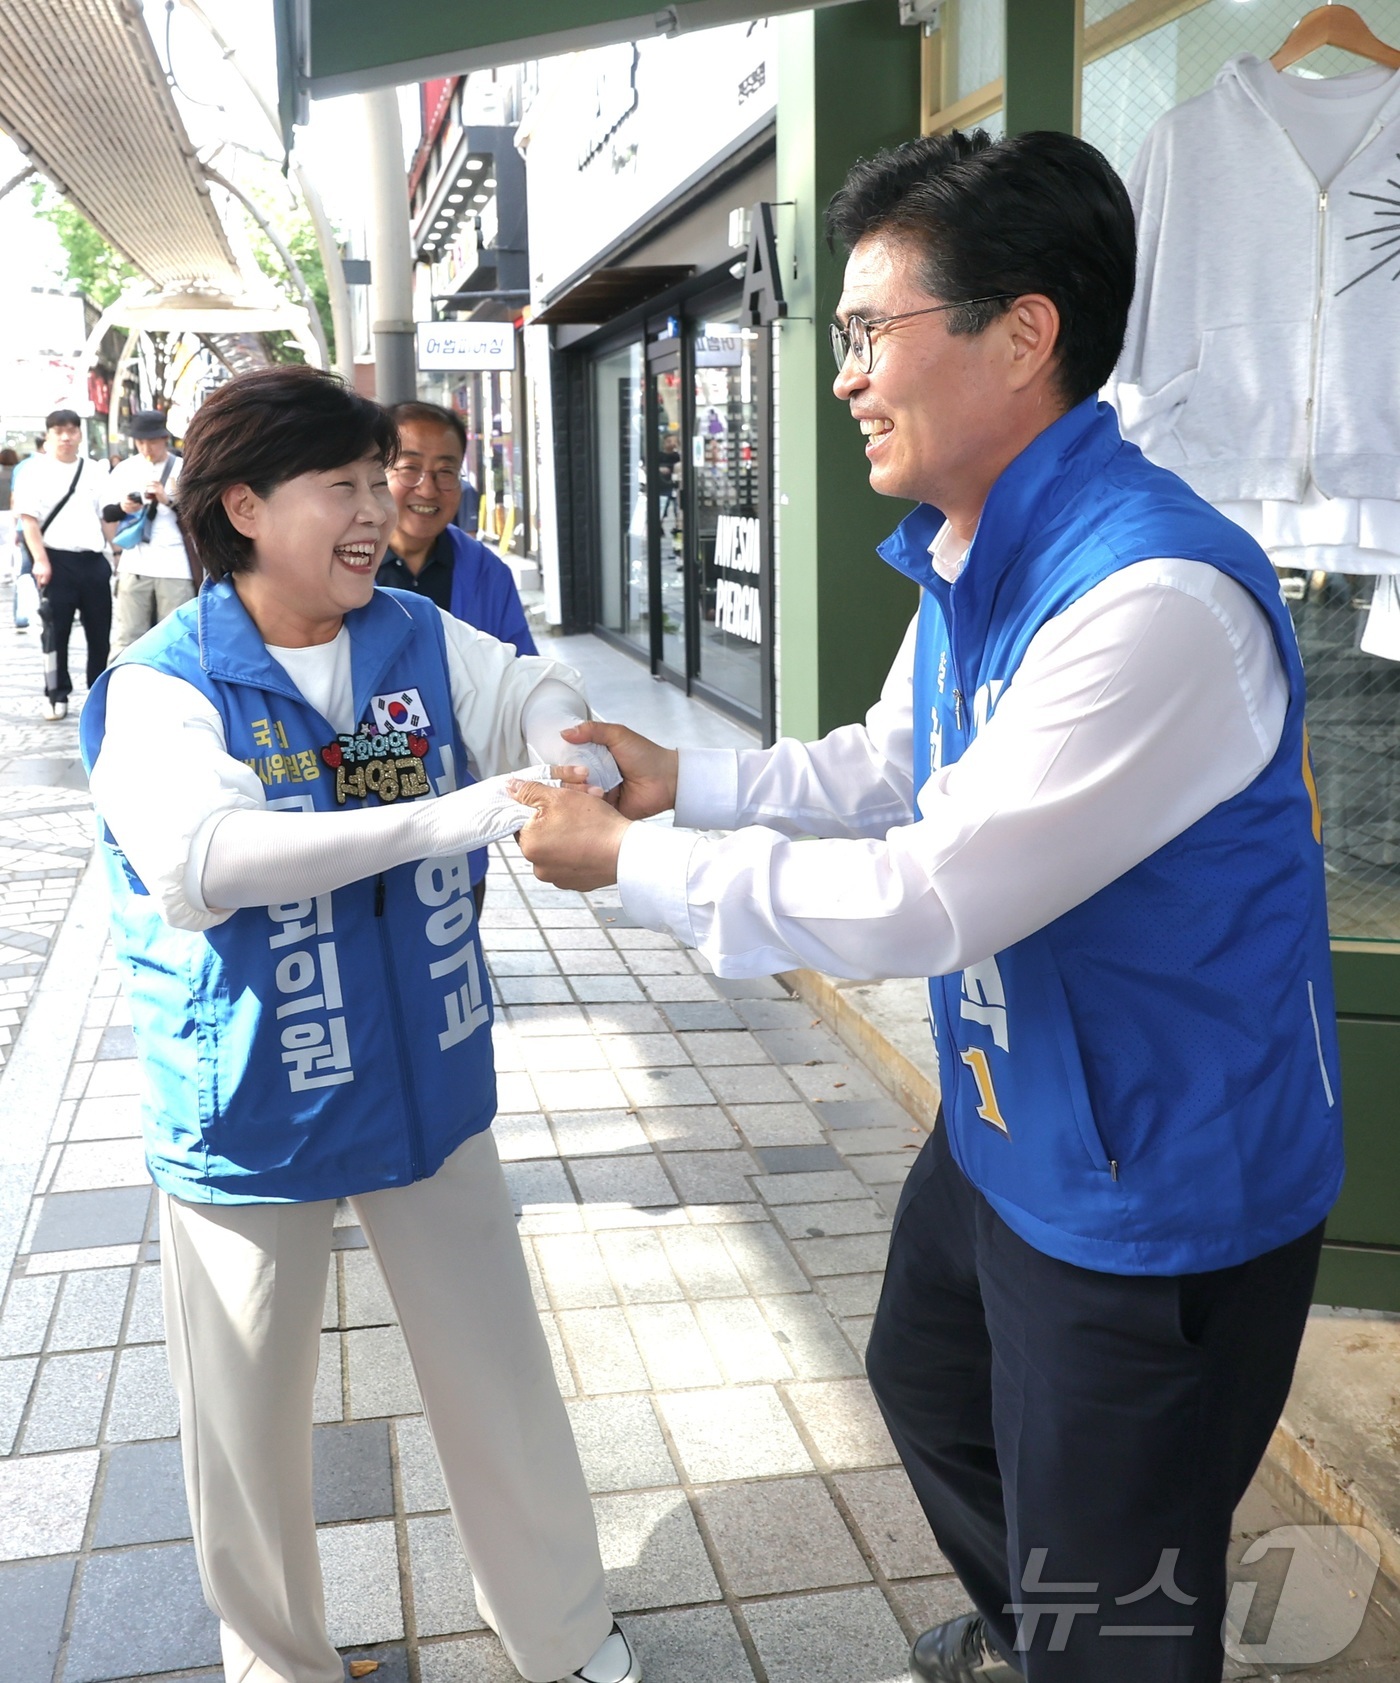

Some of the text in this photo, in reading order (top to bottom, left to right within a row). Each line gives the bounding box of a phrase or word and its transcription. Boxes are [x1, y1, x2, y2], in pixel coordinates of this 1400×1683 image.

[740, 202, 787, 327] A
[337, 757, 430, 804] 서영교
[338, 731, 411, 763] 국회의원
[960, 1046, 1010, 1136] 1
